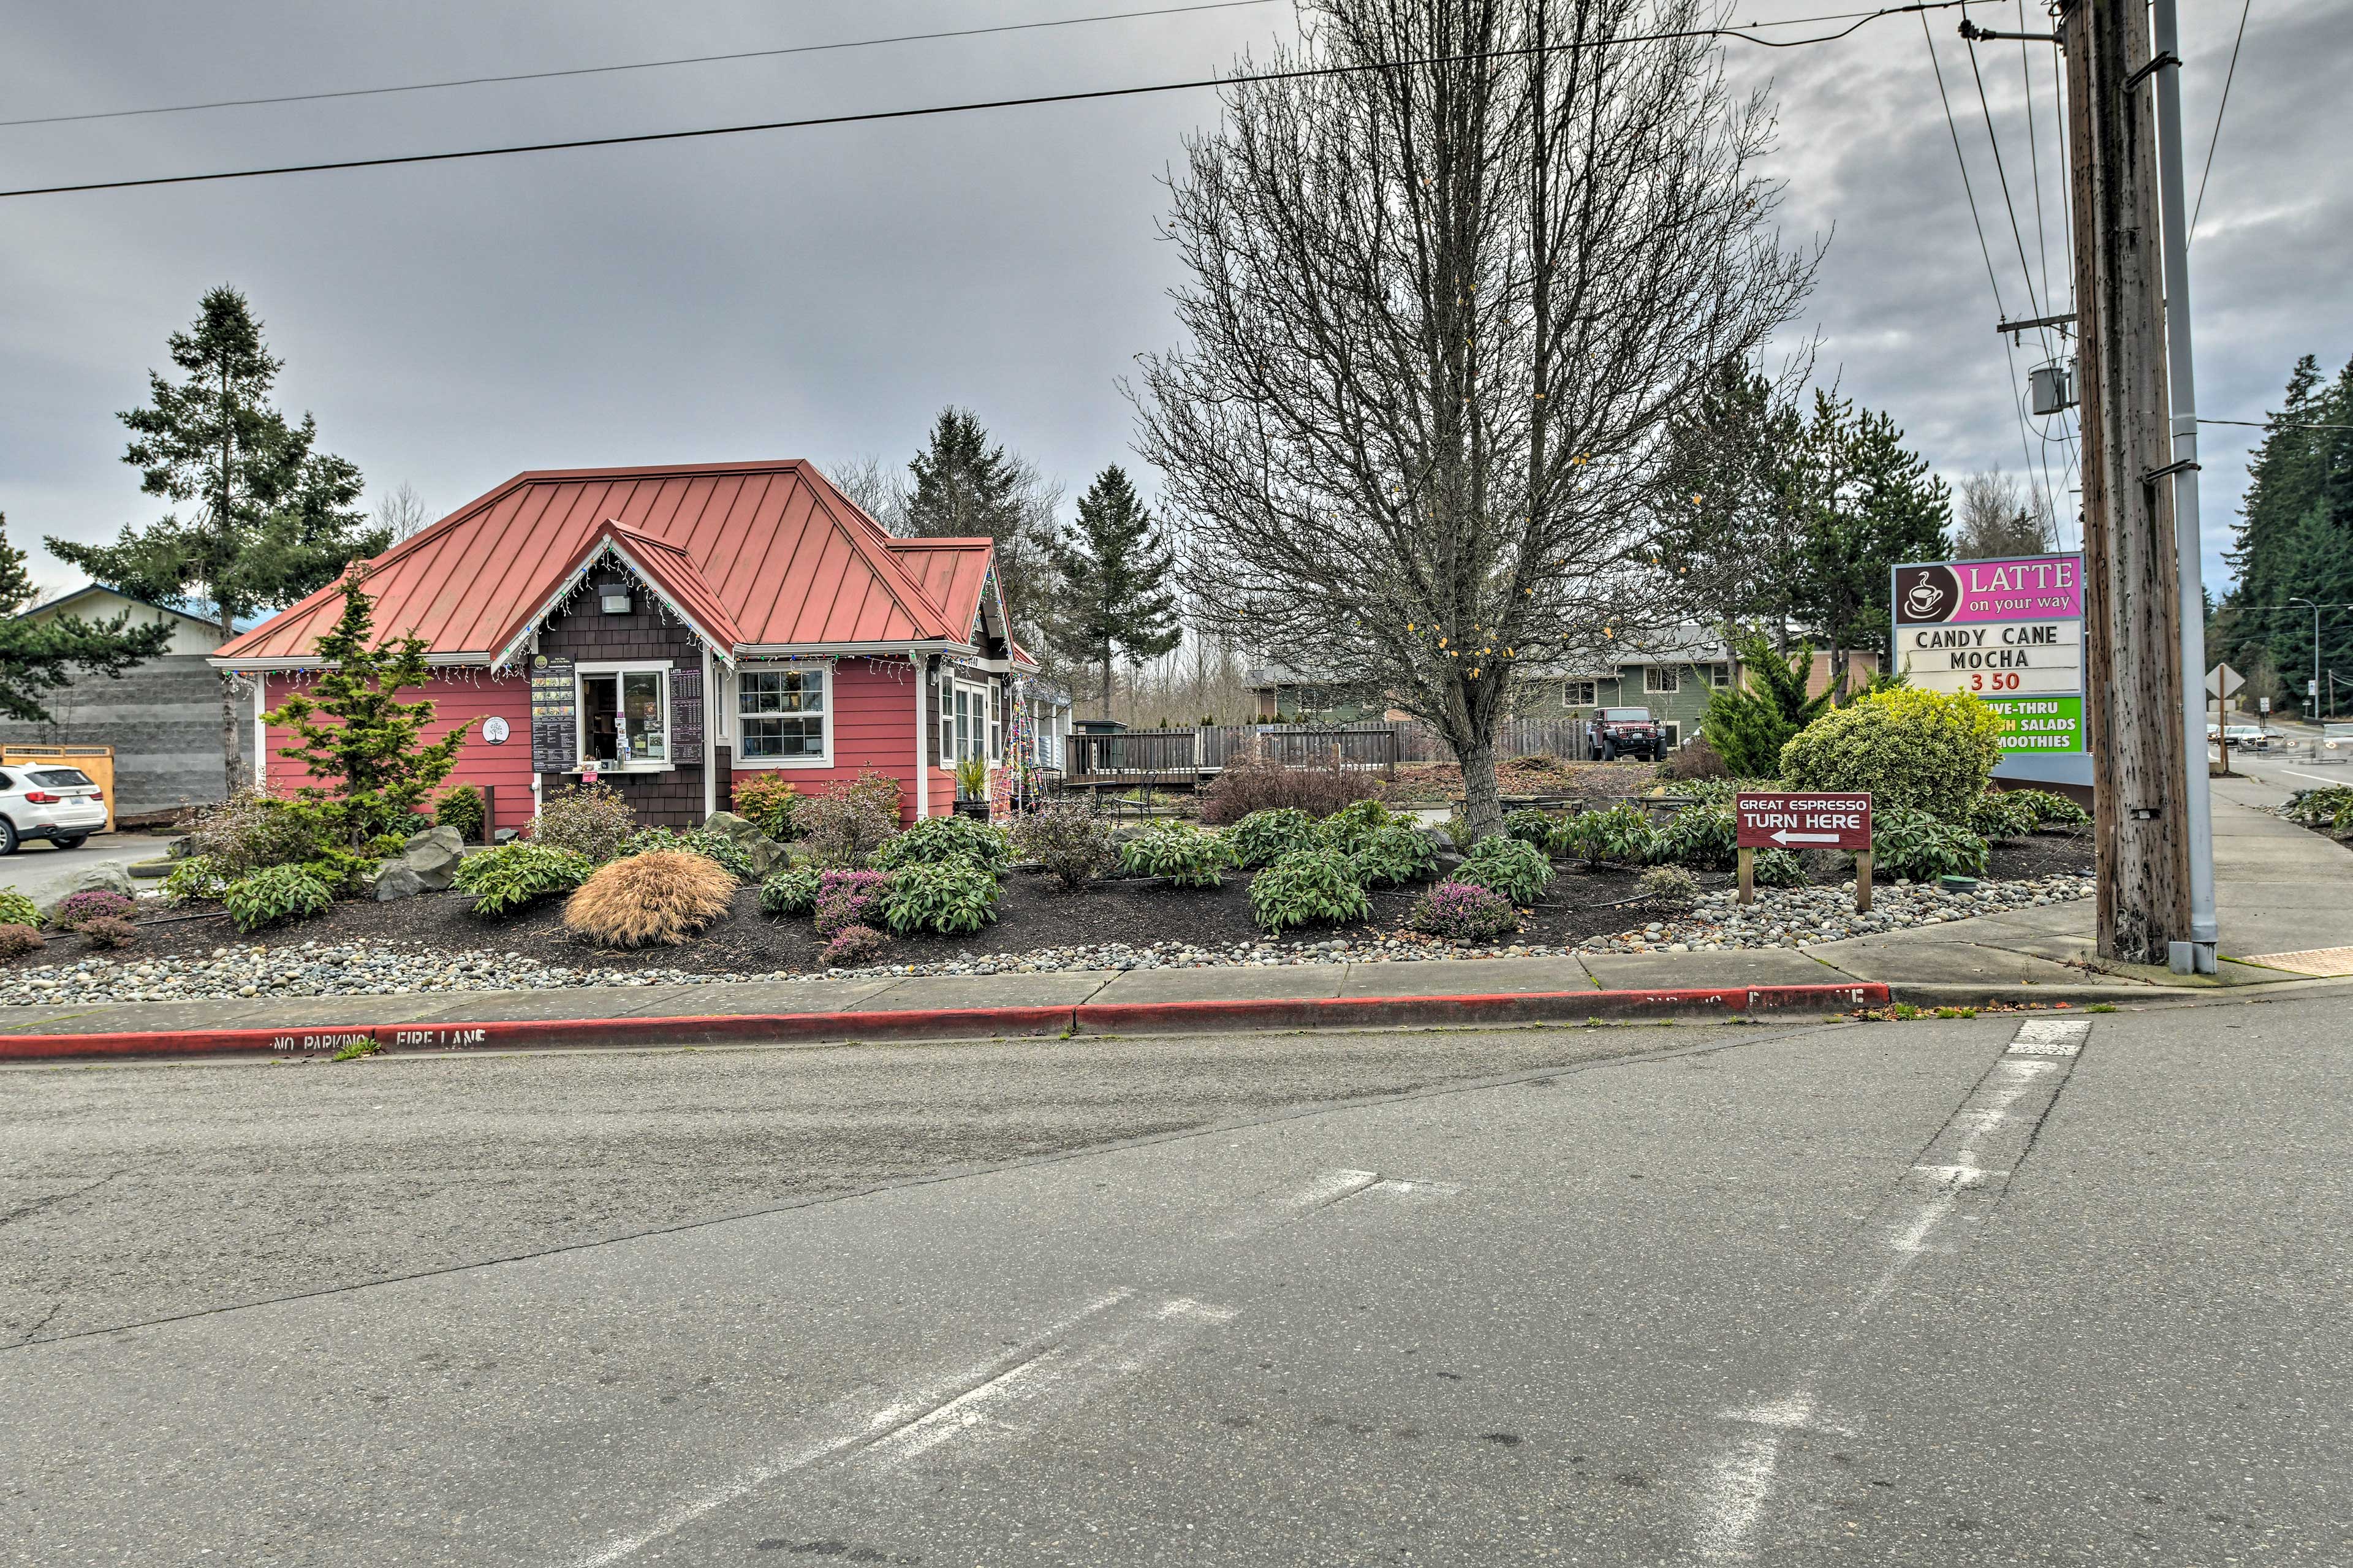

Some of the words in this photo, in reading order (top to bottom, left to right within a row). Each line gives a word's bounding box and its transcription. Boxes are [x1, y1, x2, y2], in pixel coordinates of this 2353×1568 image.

[1969, 562, 2073, 593] LATTE
[1969, 600, 1990, 612] on
[1994, 597, 2032, 613] your
[2037, 596, 2071, 610] way
[1915, 629, 1986, 648] CANDY
[2002, 626, 2057, 645] CANE
[1950, 650, 2029, 669] MOCHA
[2020, 718, 2076, 731] SALADS
[1740, 800, 1784, 810] GREAT
[1789, 800, 1866, 811] ESPRESSO
[1744, 813, 1797, 828] TURN
[1806, 814, 1860, 829] HERE
[274, 1037, 294, 1050] NO
[396, 1031, 433, 1045] FIRE
[441, 1029, 485, 1048] LANE
